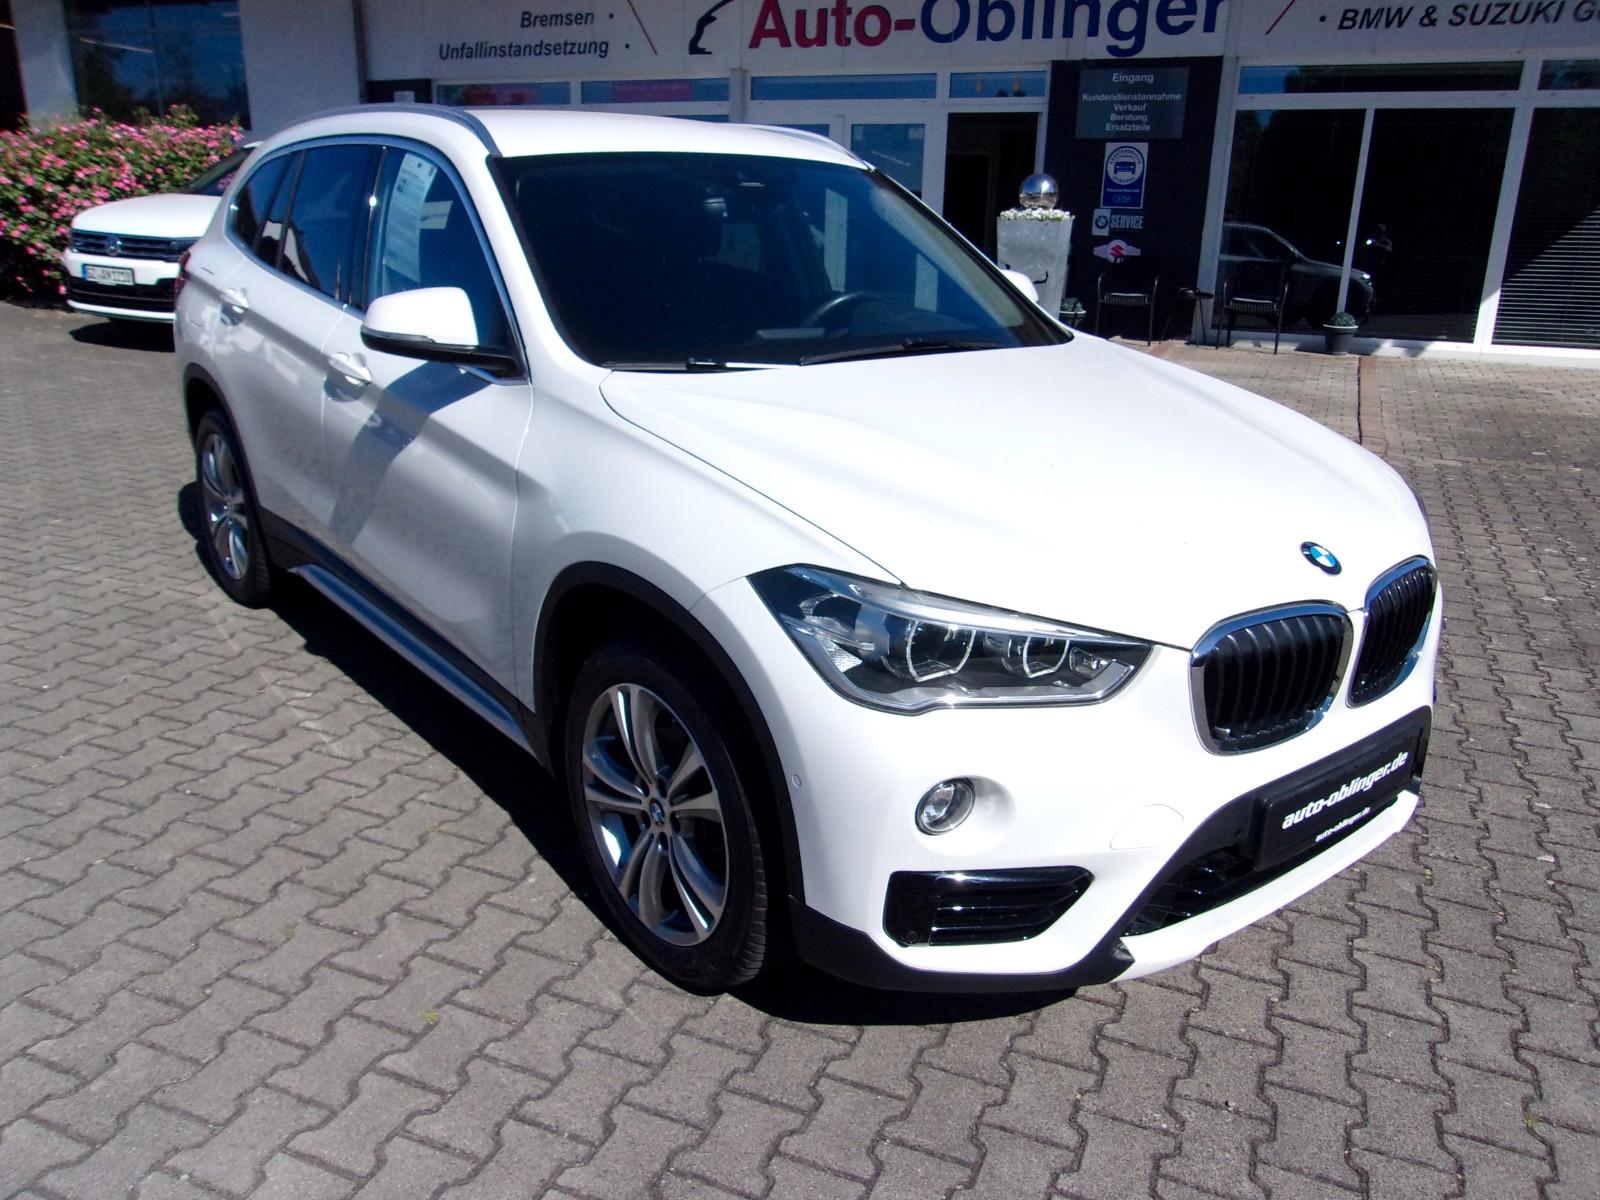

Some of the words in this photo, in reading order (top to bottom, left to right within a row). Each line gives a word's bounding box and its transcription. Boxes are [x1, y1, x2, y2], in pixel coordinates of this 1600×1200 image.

[520, 11, 594, 28] Bremsen
[1338, 6, 1415, 31] BMW
[1419, 5, 1438, 28] &
[1448, 0, 1566, 27] SUZUKI
[1572, 0, 1600, 23] G
[748, 0, 1227, 58] Auto-Oblinger
[438, 39, 610, 60] Unfallinstandsetzung
[1112, 72, 1155, 84] Eingang
[1082, 92, 1182, 102] Kundendienstannahme
[1113, 103, 1147, 111] Verkauf
[1110, 113, 1148, 122] Beratung
[1105, 122, 1151, 131] Ersatzteile
[1110, 215, 1144, 228] SERVICE
[1281, 752, 1408, 830] auto-oblinger.de
